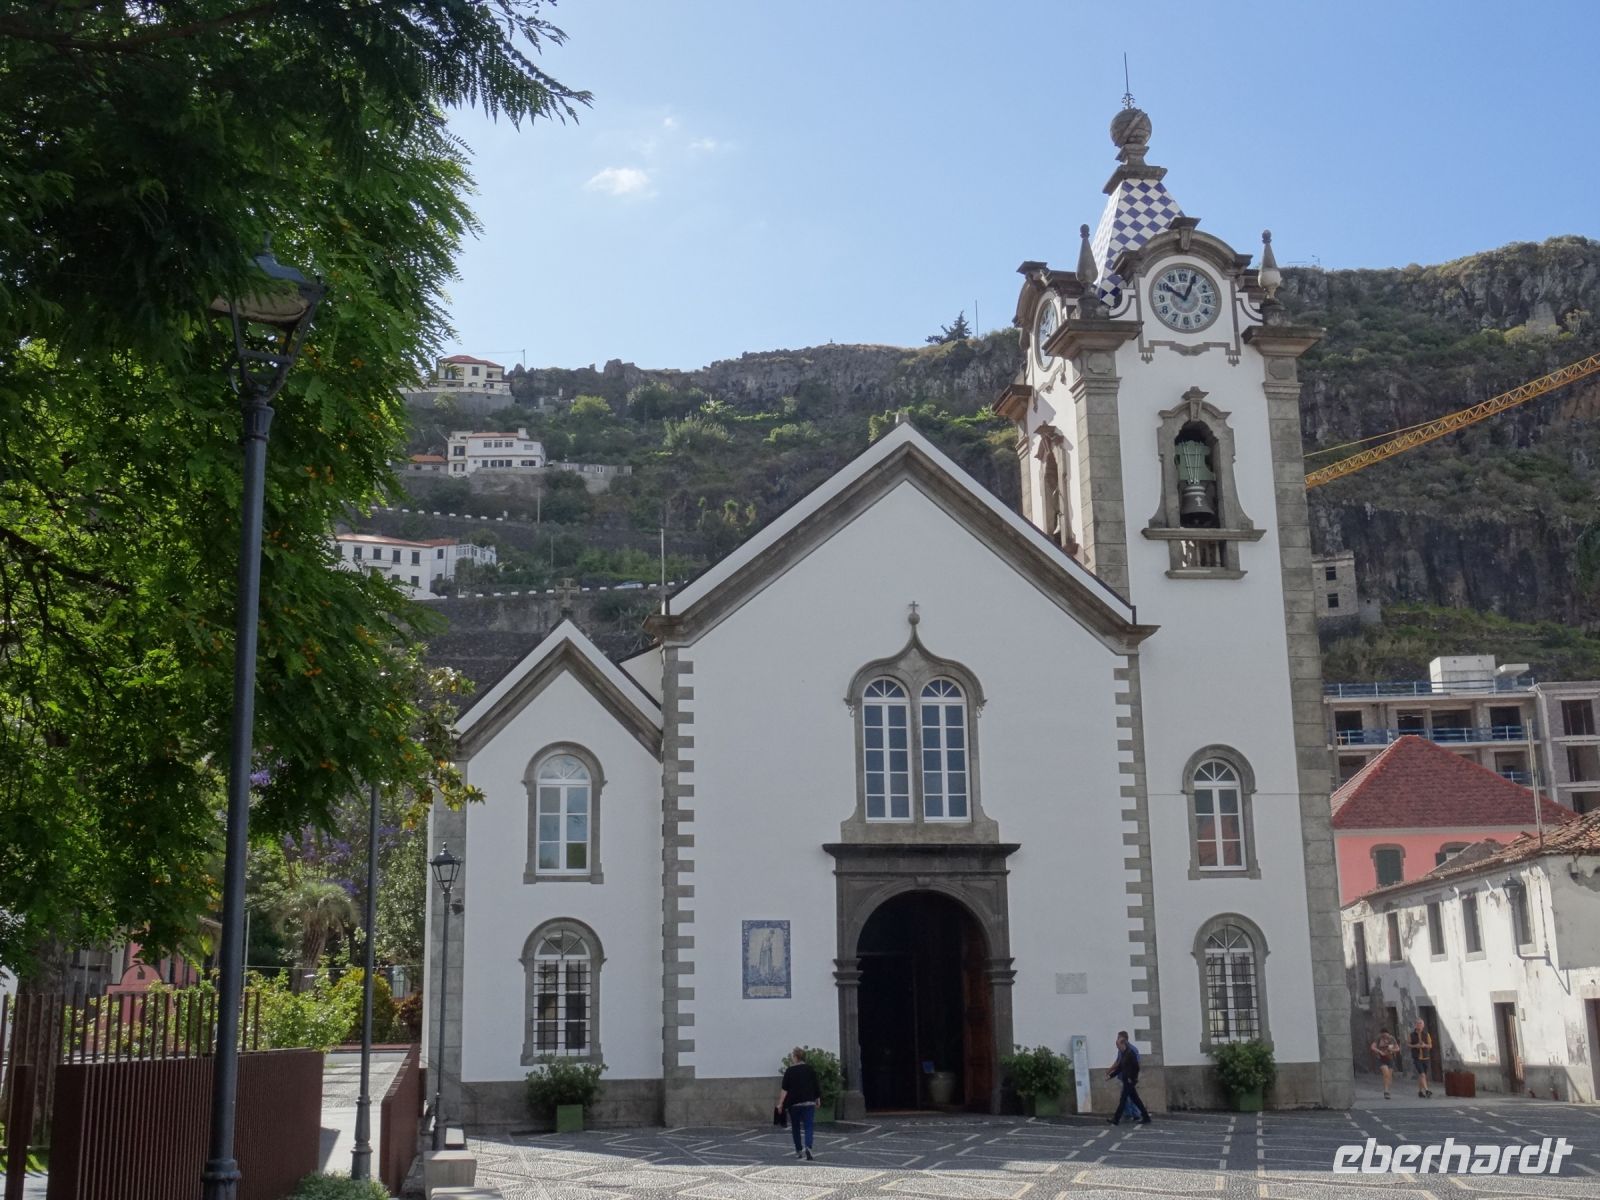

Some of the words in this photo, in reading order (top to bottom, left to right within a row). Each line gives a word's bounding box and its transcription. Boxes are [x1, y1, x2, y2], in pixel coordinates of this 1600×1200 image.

[1178, 273, 1187, 282] 12
[1159, 294, 1165, 303] 9
[1162, 305, 1168, 314] 8
[1202, 307, 1209, 315] 4
[1172, 313, 1178, 322] 7
[1183, 316, 1190, 325] 6
[1194, 314, 1201, 323] 5
